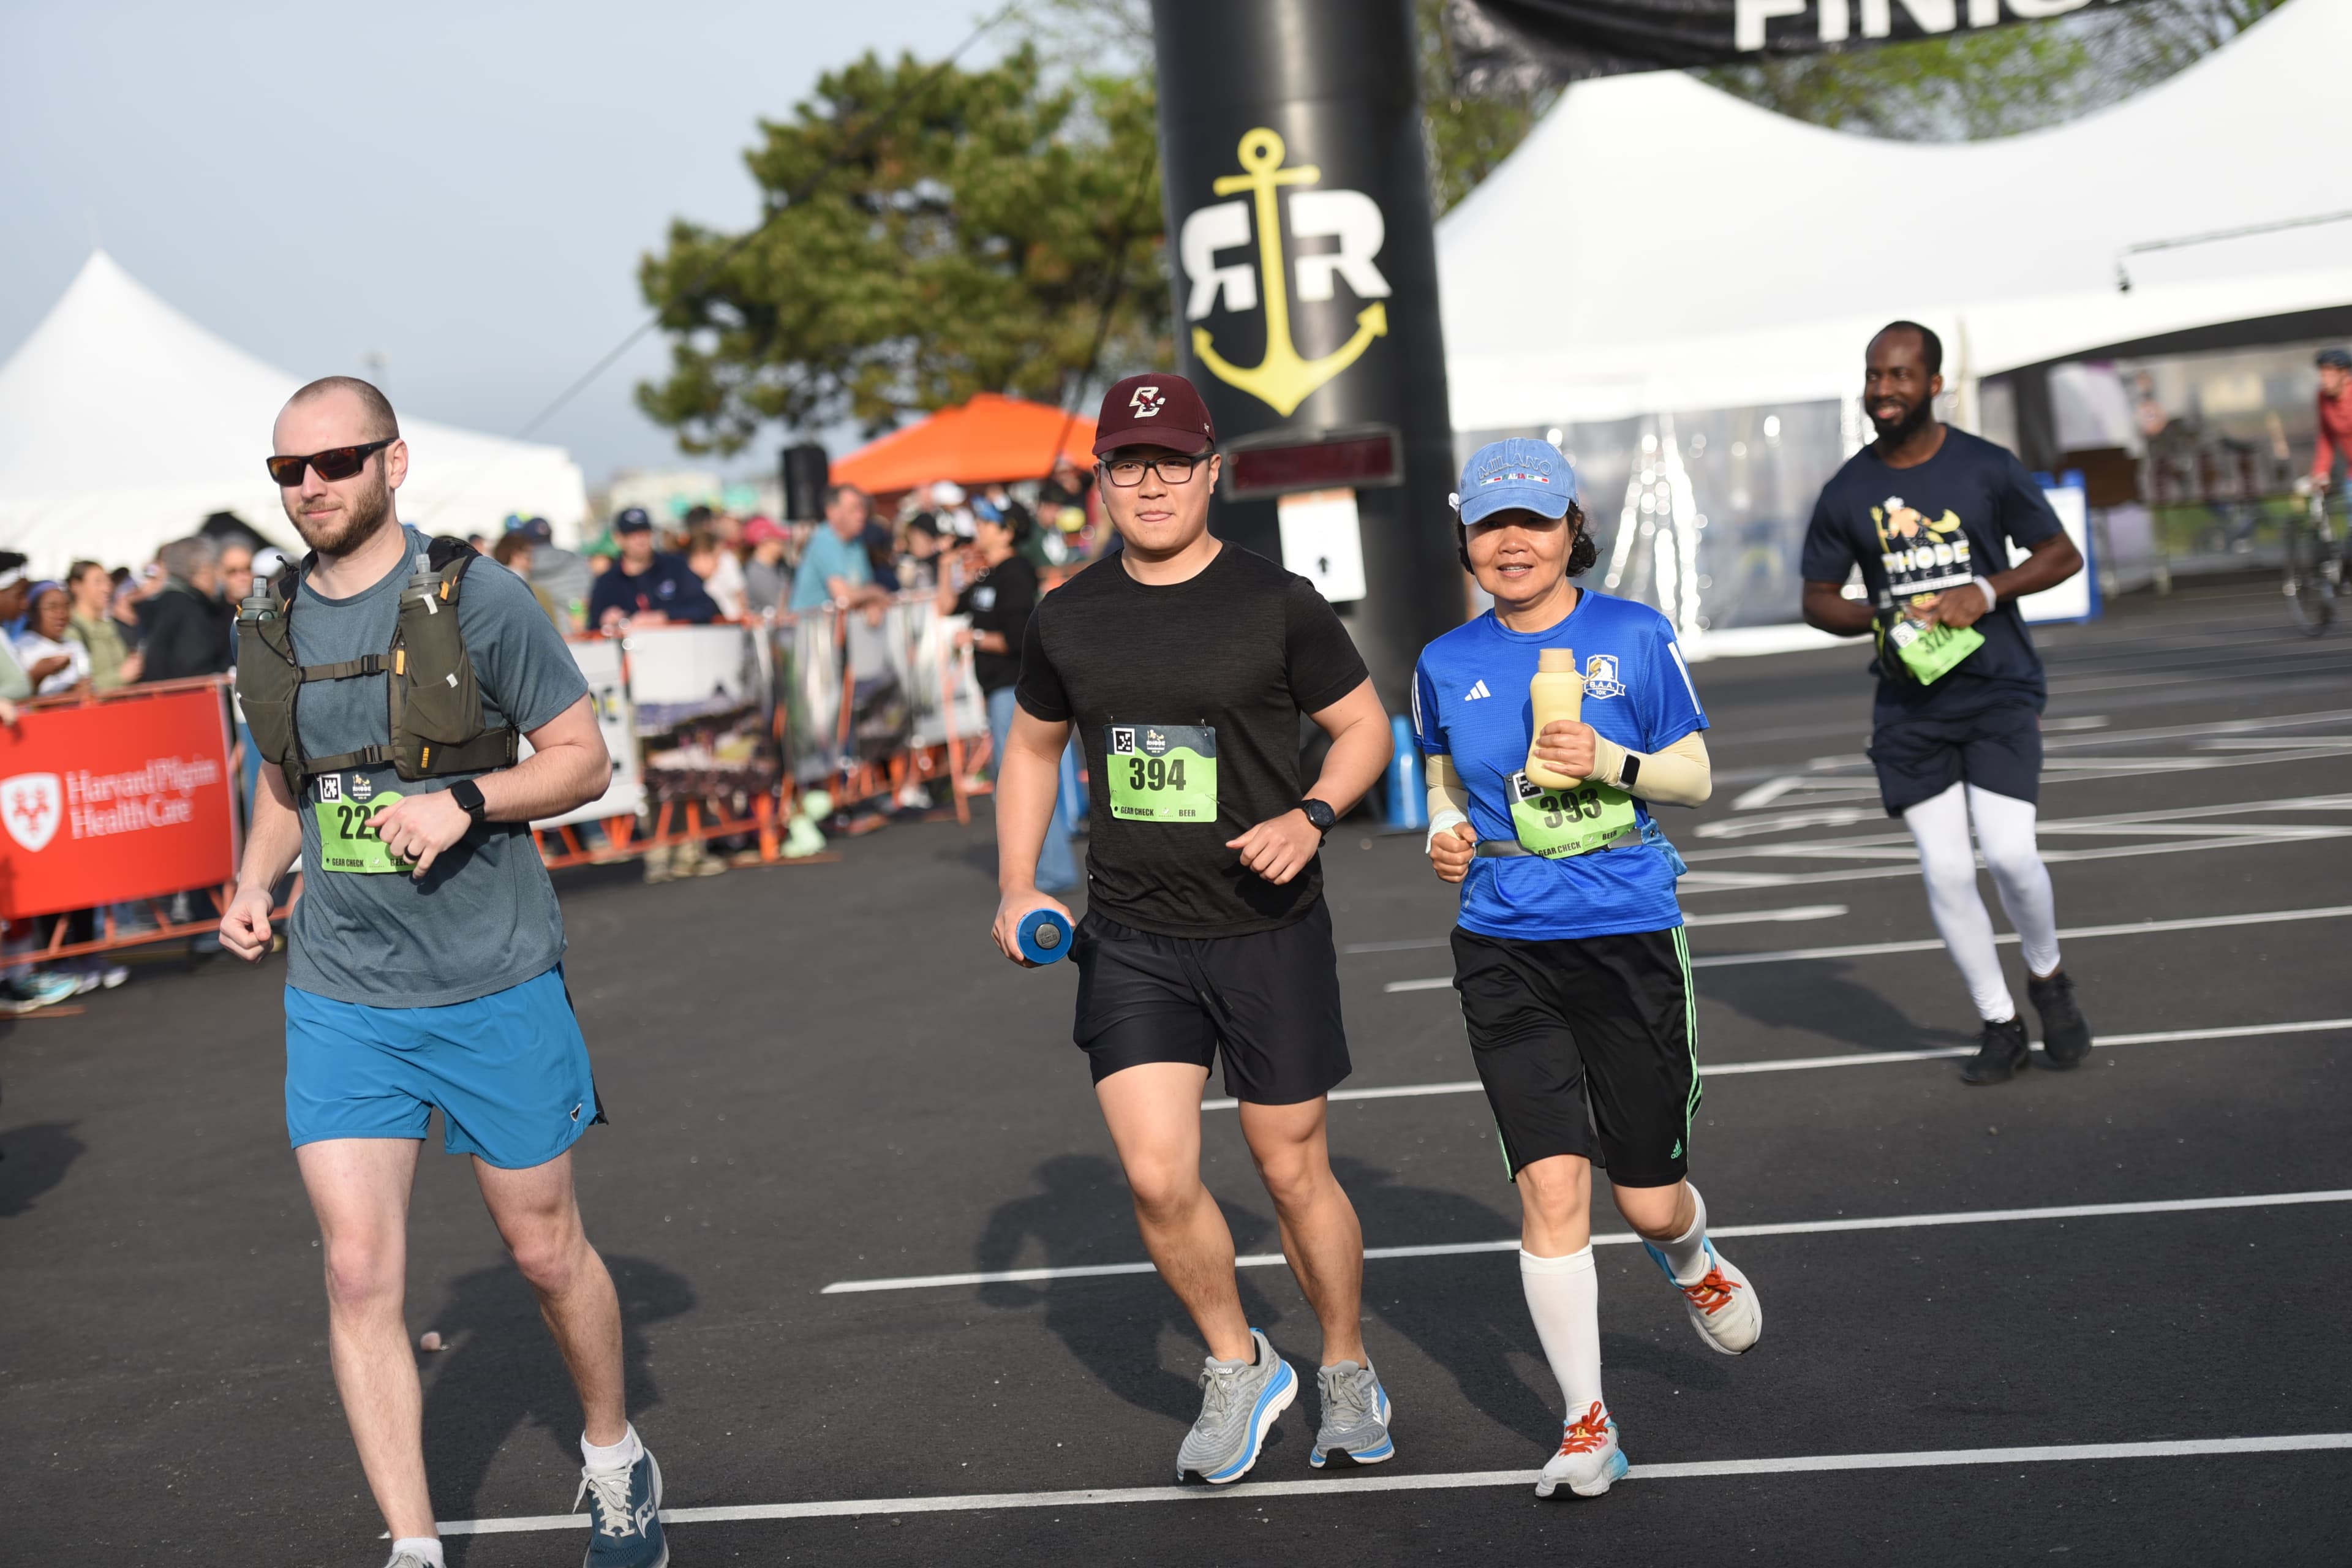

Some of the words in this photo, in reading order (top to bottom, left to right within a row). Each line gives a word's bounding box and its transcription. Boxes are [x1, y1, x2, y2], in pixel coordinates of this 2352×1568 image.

[1477, 453, 1553, 480] MILANO
[66, 756, 156, 805] Harvard
[1129, 758, 1186, 791] 394
[70, 796, 149, 840] Health
[146, 793, 194, 827] Care
[1120, 806, 1134, 815] GEAR
[1134, 807, 1154, 816] CHECK
[1539, 788, 1602, 829] 393
[1538, 847, 1557, 856] GEAR
[1557, 841, 1581, 853] CHECK
[1602, 830, 1617, 840] BEER
[332, 858, 345, 866] GEAR
[345, 859, 364, 868] CHECK
